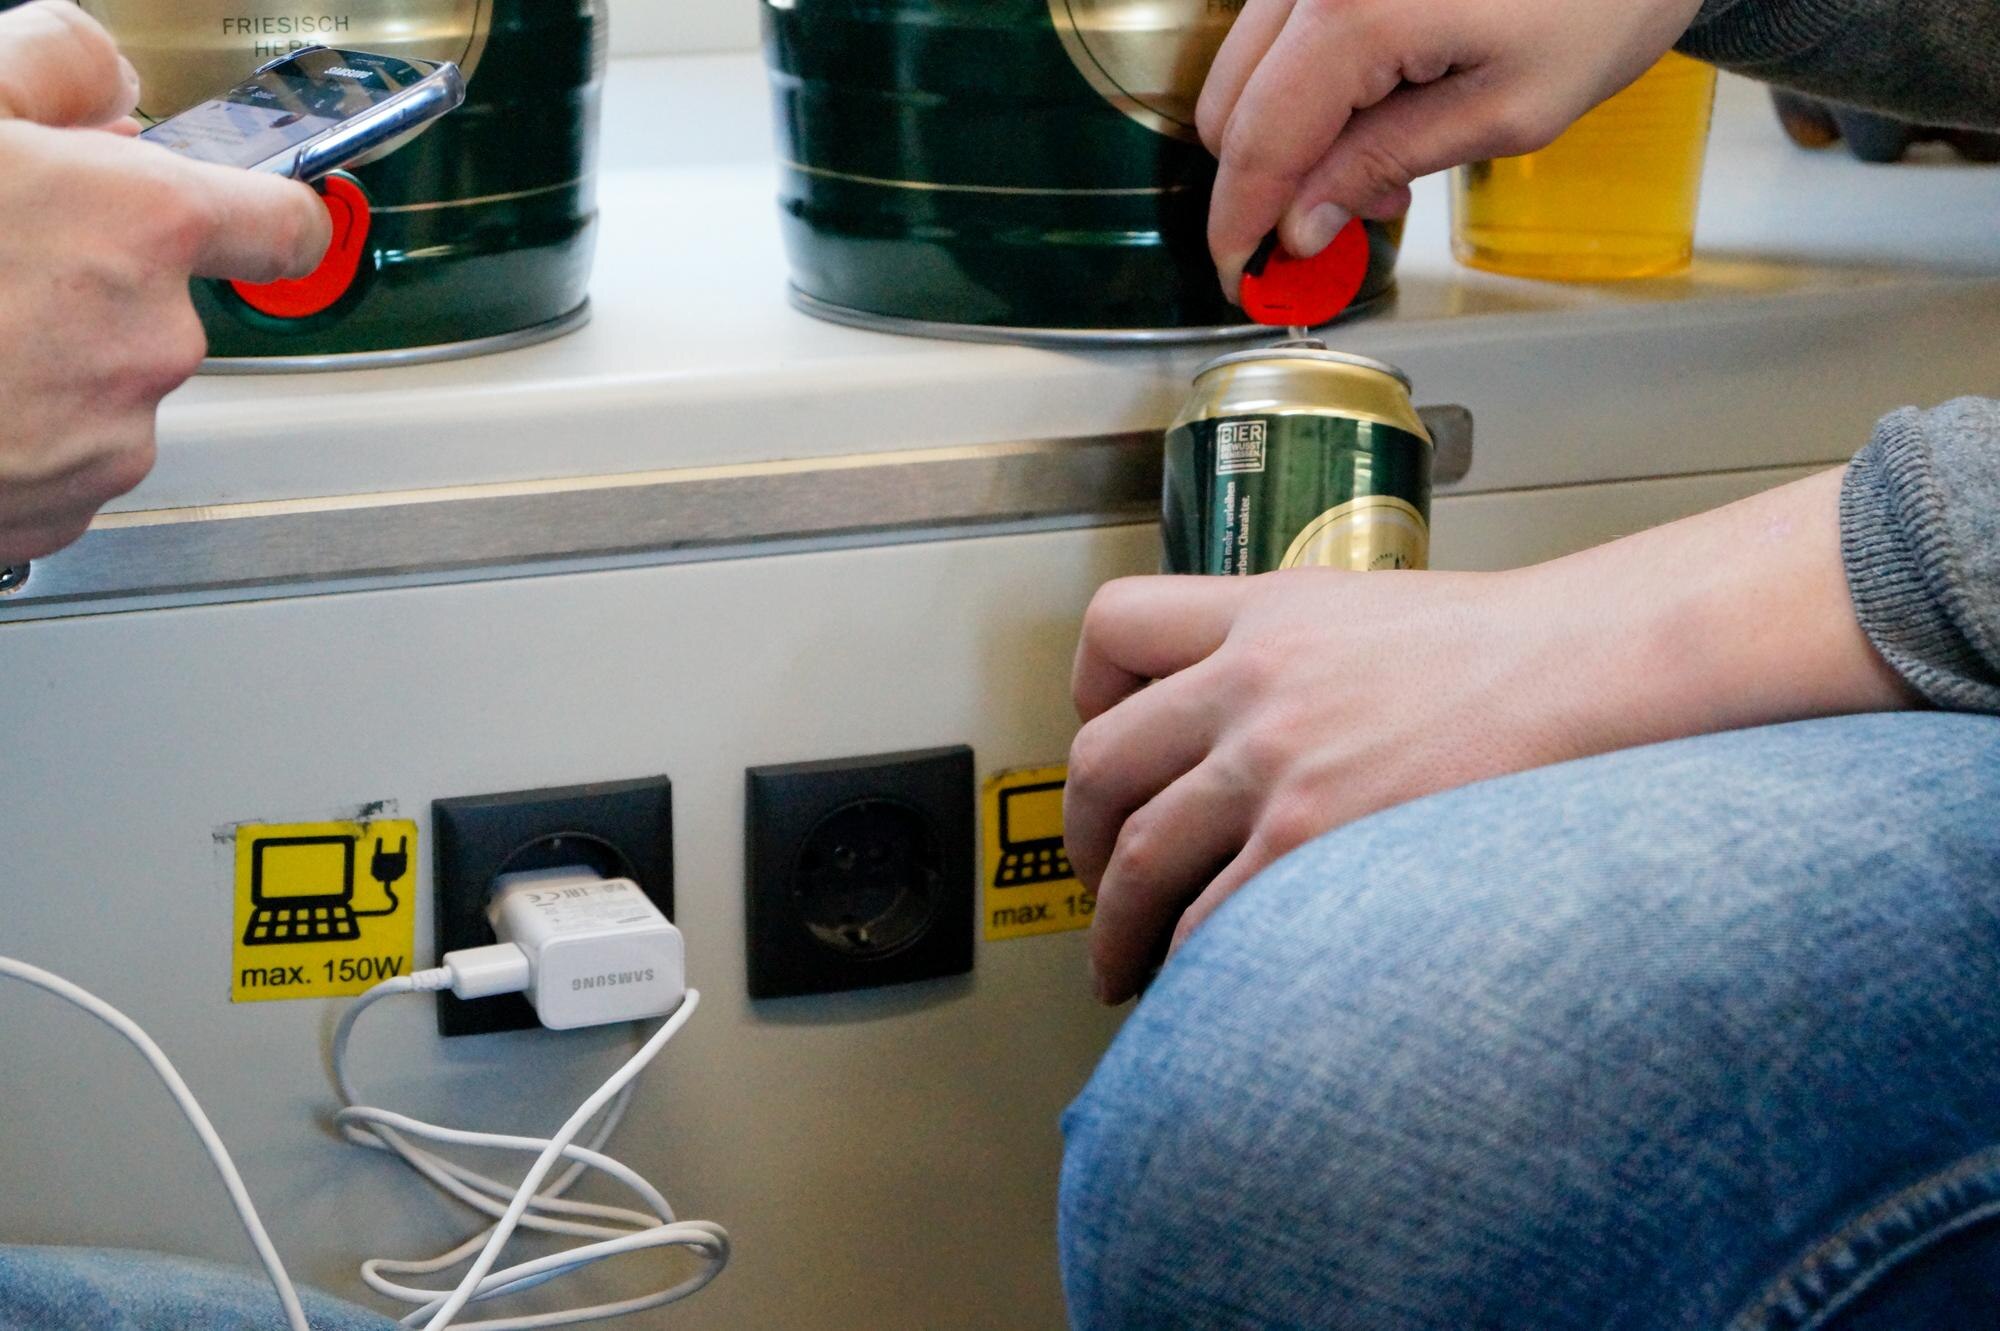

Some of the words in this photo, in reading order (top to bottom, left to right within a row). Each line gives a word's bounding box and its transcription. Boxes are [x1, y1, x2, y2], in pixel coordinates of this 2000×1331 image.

[222, 15, 350, 35] FRIESISCH
[1221, 424, 1262, 443] BIER
[1065, 893, 1097, 917] 15
[241, 965, 312, 988] max.
[323, 955, 404, 983] 150W
[572, 968, 655, 991] SAMSUNG
